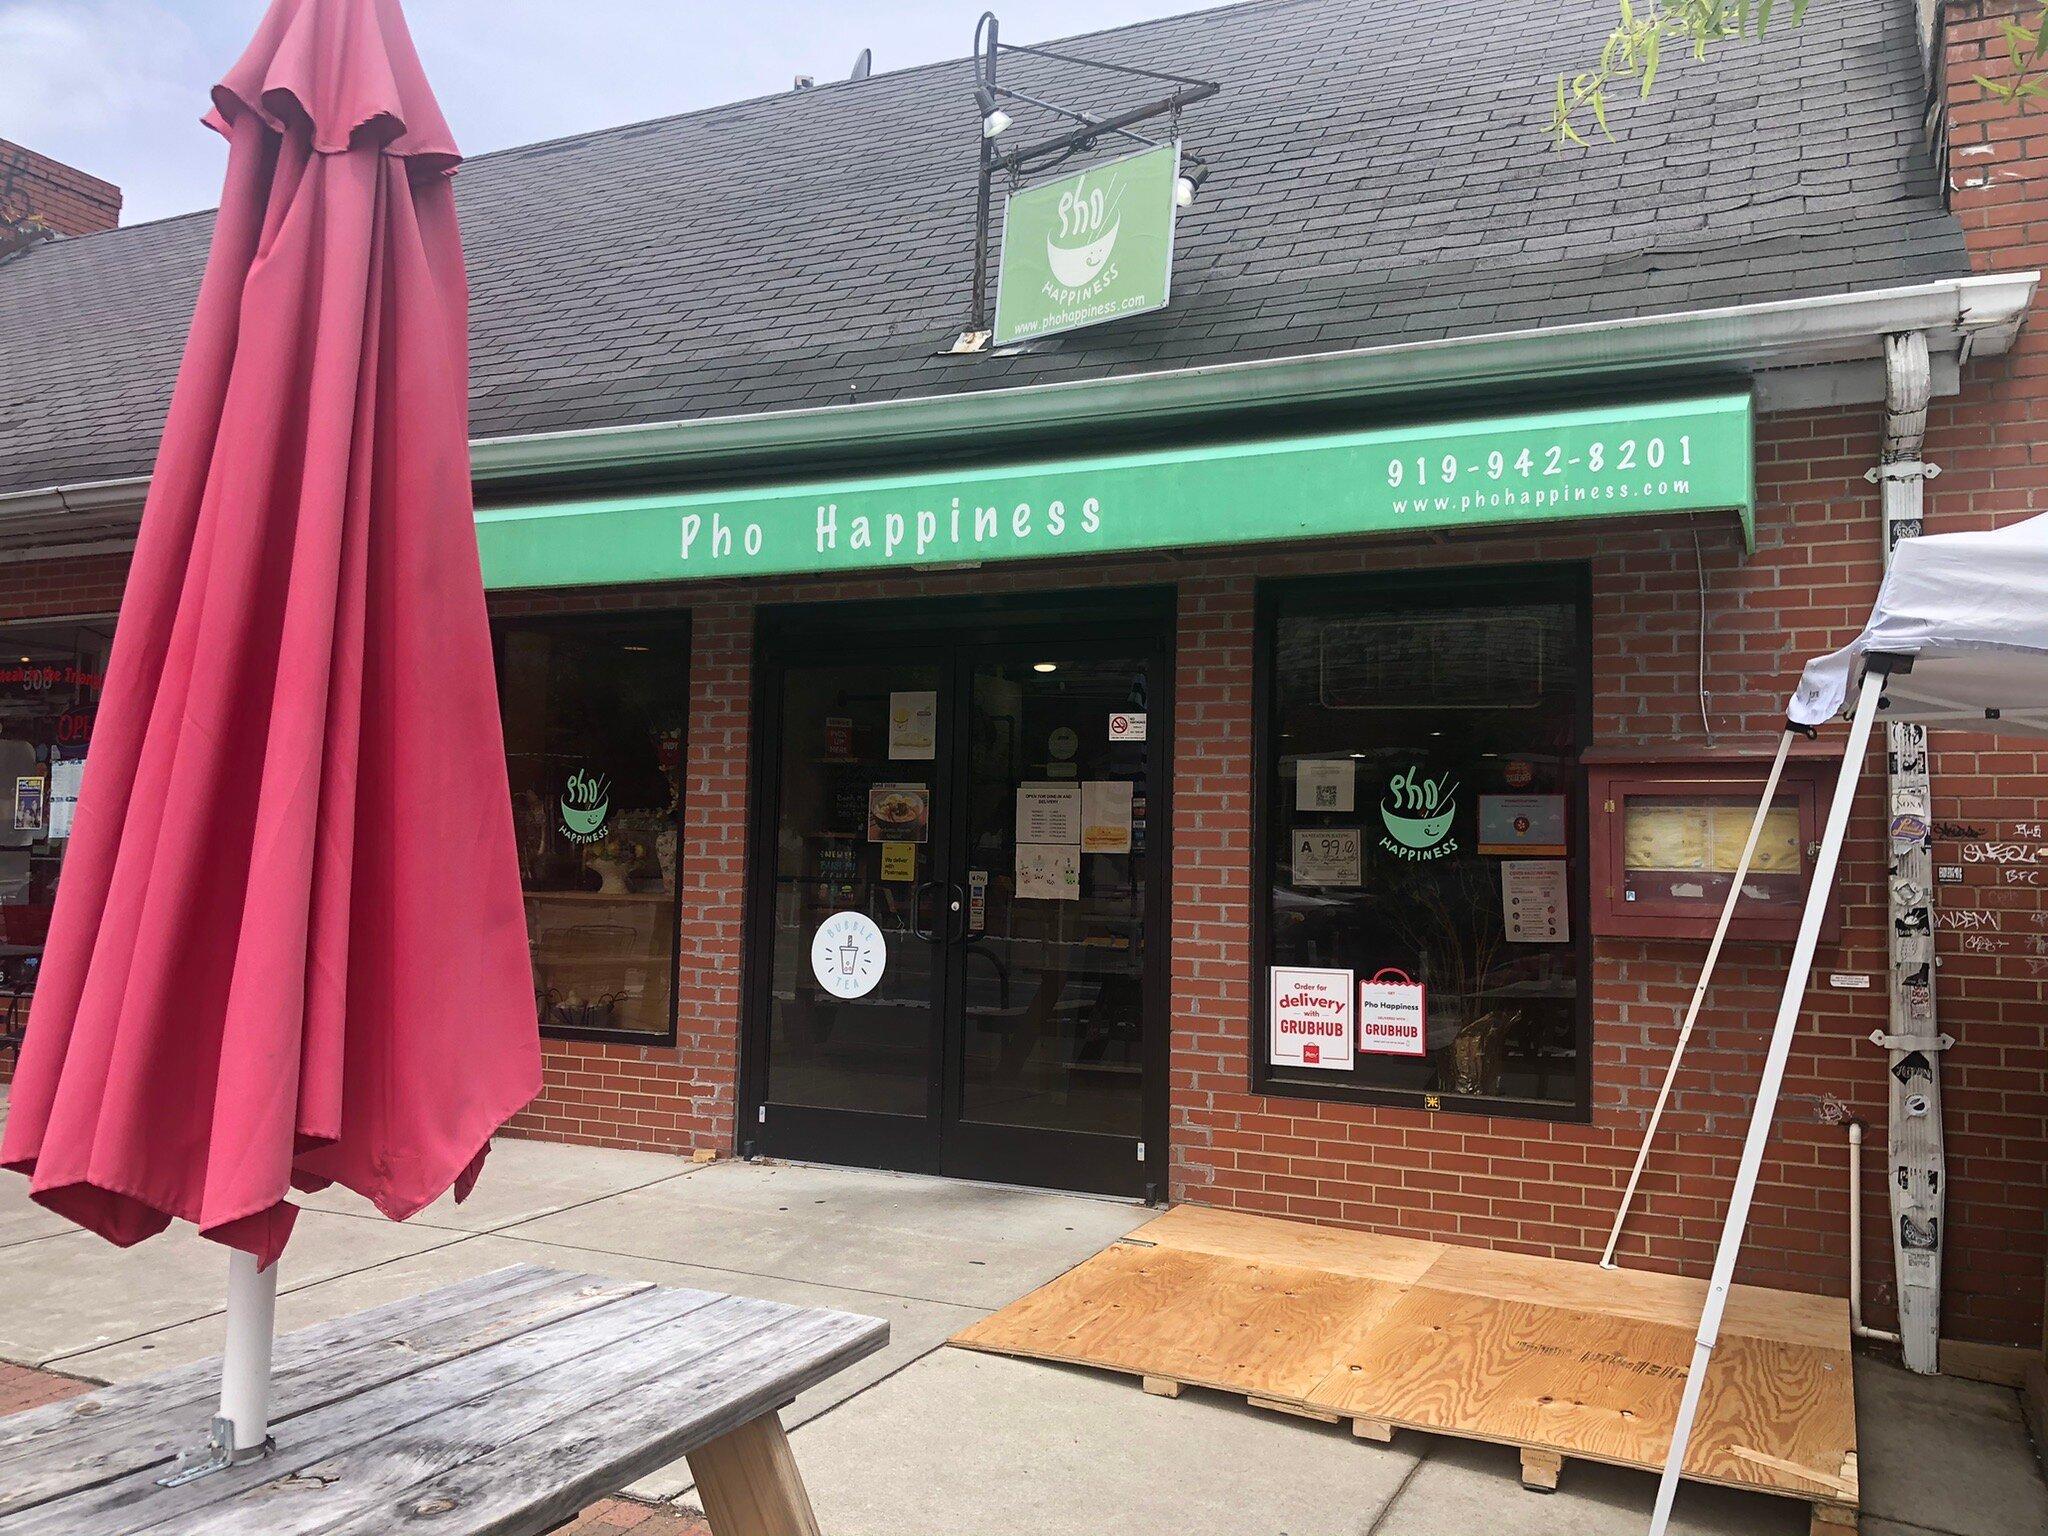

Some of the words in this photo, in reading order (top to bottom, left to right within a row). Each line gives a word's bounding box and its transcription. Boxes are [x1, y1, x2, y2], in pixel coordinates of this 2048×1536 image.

[1041, 263, 1119, 306] HAPPINESS
[1014, 294, 1145, 335] www.phohappiness.com
[1387, 435, 1691, 488] 919-942-8201
[1392, 479, 1690, 514] www.phohappiness.com
[680, 513, 763, 560] Pho
[815, 497, 1101, 558] Happiness
[558, 824, 609, 845] HAPPINESS
[1301, 841, 1312, 853] A
[1379, 837, 1459, 861] HAPPINESS
[827, 921, 874, 941] BUBBLE
[836, 977, 859, 990] TEA
[1294, 982, 1315, 991] Order
[1316, 983, 1328, 992] for
[1279, 993, 1346, 1014] delivery
[1364, 1000, 1379, 1009] Pho
[1380, 1001, 1419, 1012] Happiness
[1280, 1019, 1344, 1037] GRUBHUB
[1365, 1023, 1418, 1038] GRUBHUB
